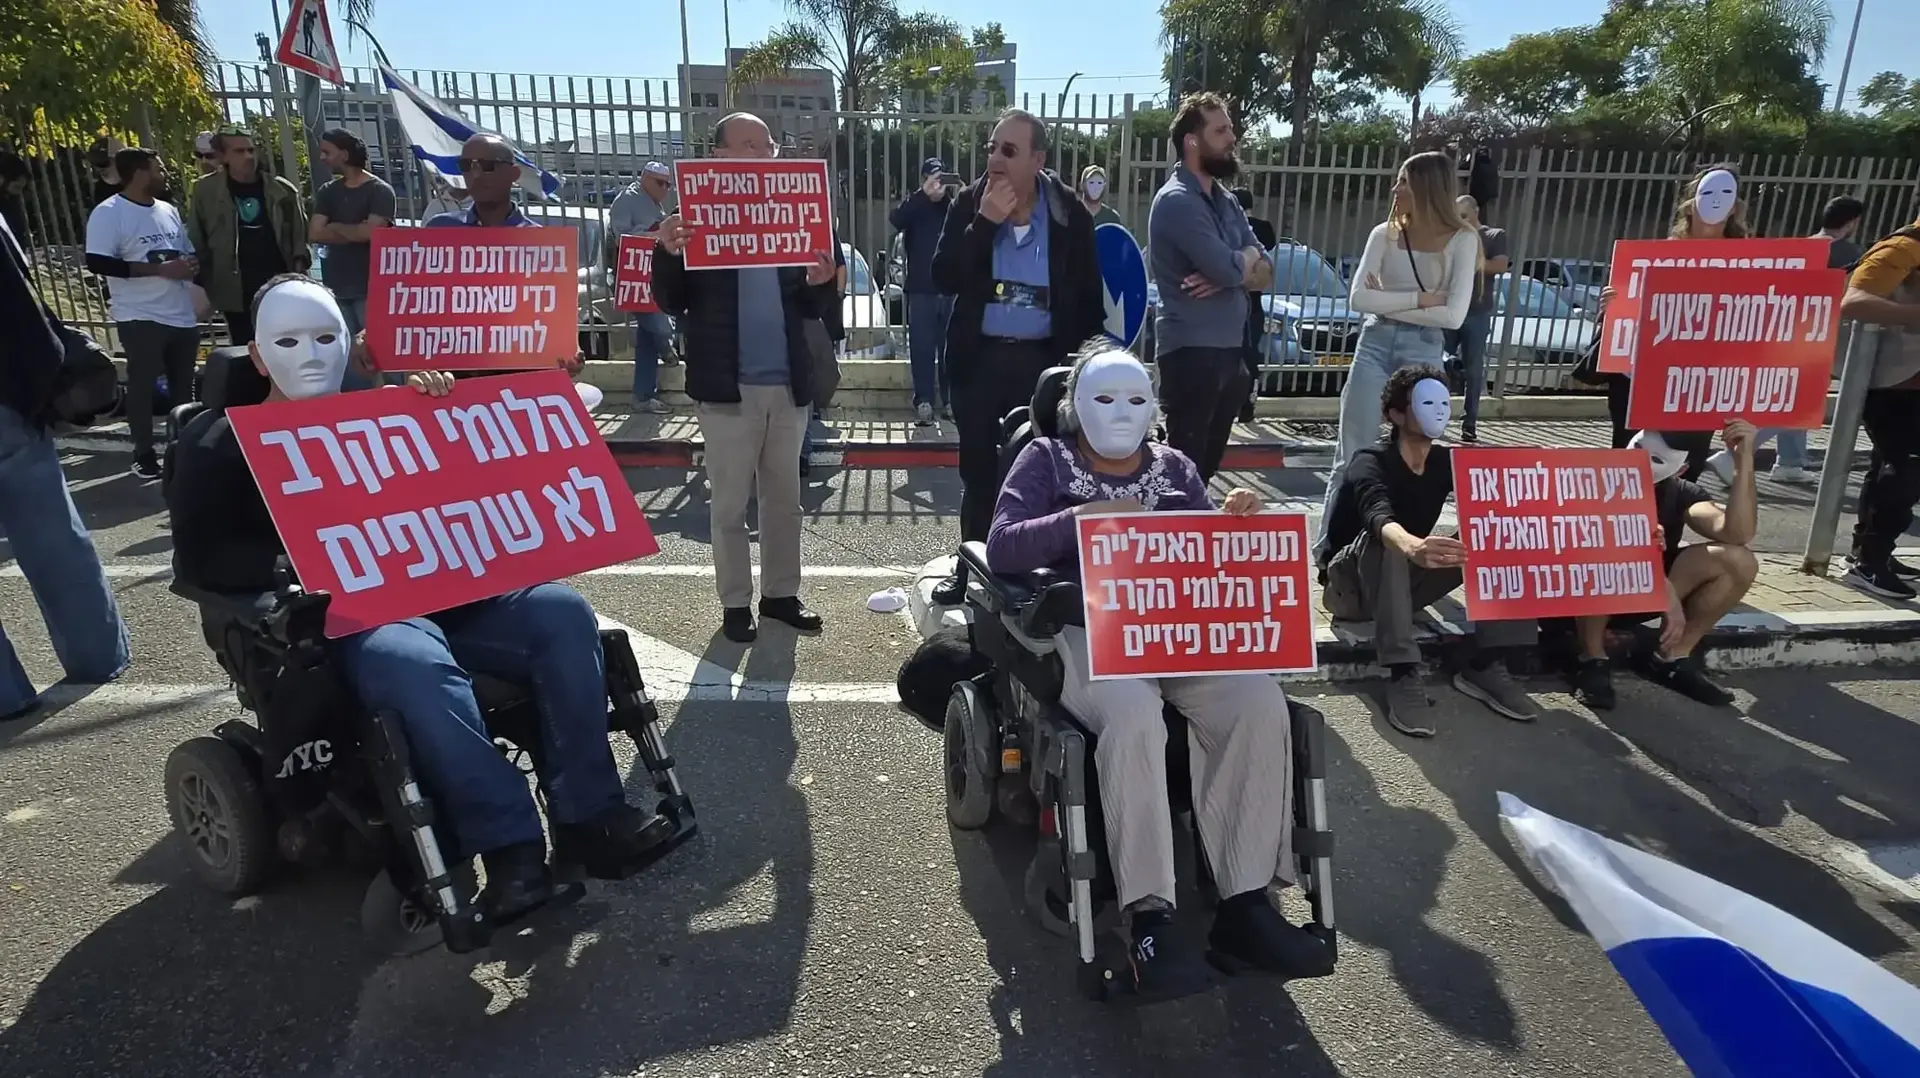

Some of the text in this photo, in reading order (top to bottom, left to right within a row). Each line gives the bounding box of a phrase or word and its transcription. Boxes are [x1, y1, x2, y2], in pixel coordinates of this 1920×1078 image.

[684, 169, 821, 197] תופסק האפלייה
[690, 200, 821, 228] בין הלומי הקרב
[380, 241, 568, 278] בפקודתכם נשלחנו
[705, 231, 810, 255] לנכים פיזיים
[389, 282, 555, 314] כדי שאתם תוכלו
[1650, 293, 1712, 346] פצועי
[1714, 285, 1797, 342] מלחמה
[1801, 296, 1832, 342] נכי
[396, 320, 547, 360] לחיות והופקרנו
[1664, 367, 1798, 412] נפש נשכחים
[260, 388, 589, 494] הלומי הקרב
[1469, 461, 1643, 507] הגיע הזמן לתקן את
[317, 466, 616, 593] לא שקופים
[1091, 526, 1298, 568] תופסק האפלייה
[1470, 510, 1650, 554] חוסר הצדק והאפליה
[1100, 571, 1297, 616] בין הלומי הקרב
[1477, 562, 1653, 600] שנמשכים כבר שנים
[1123, 615, 1281, 656] לנכים פיזיים
